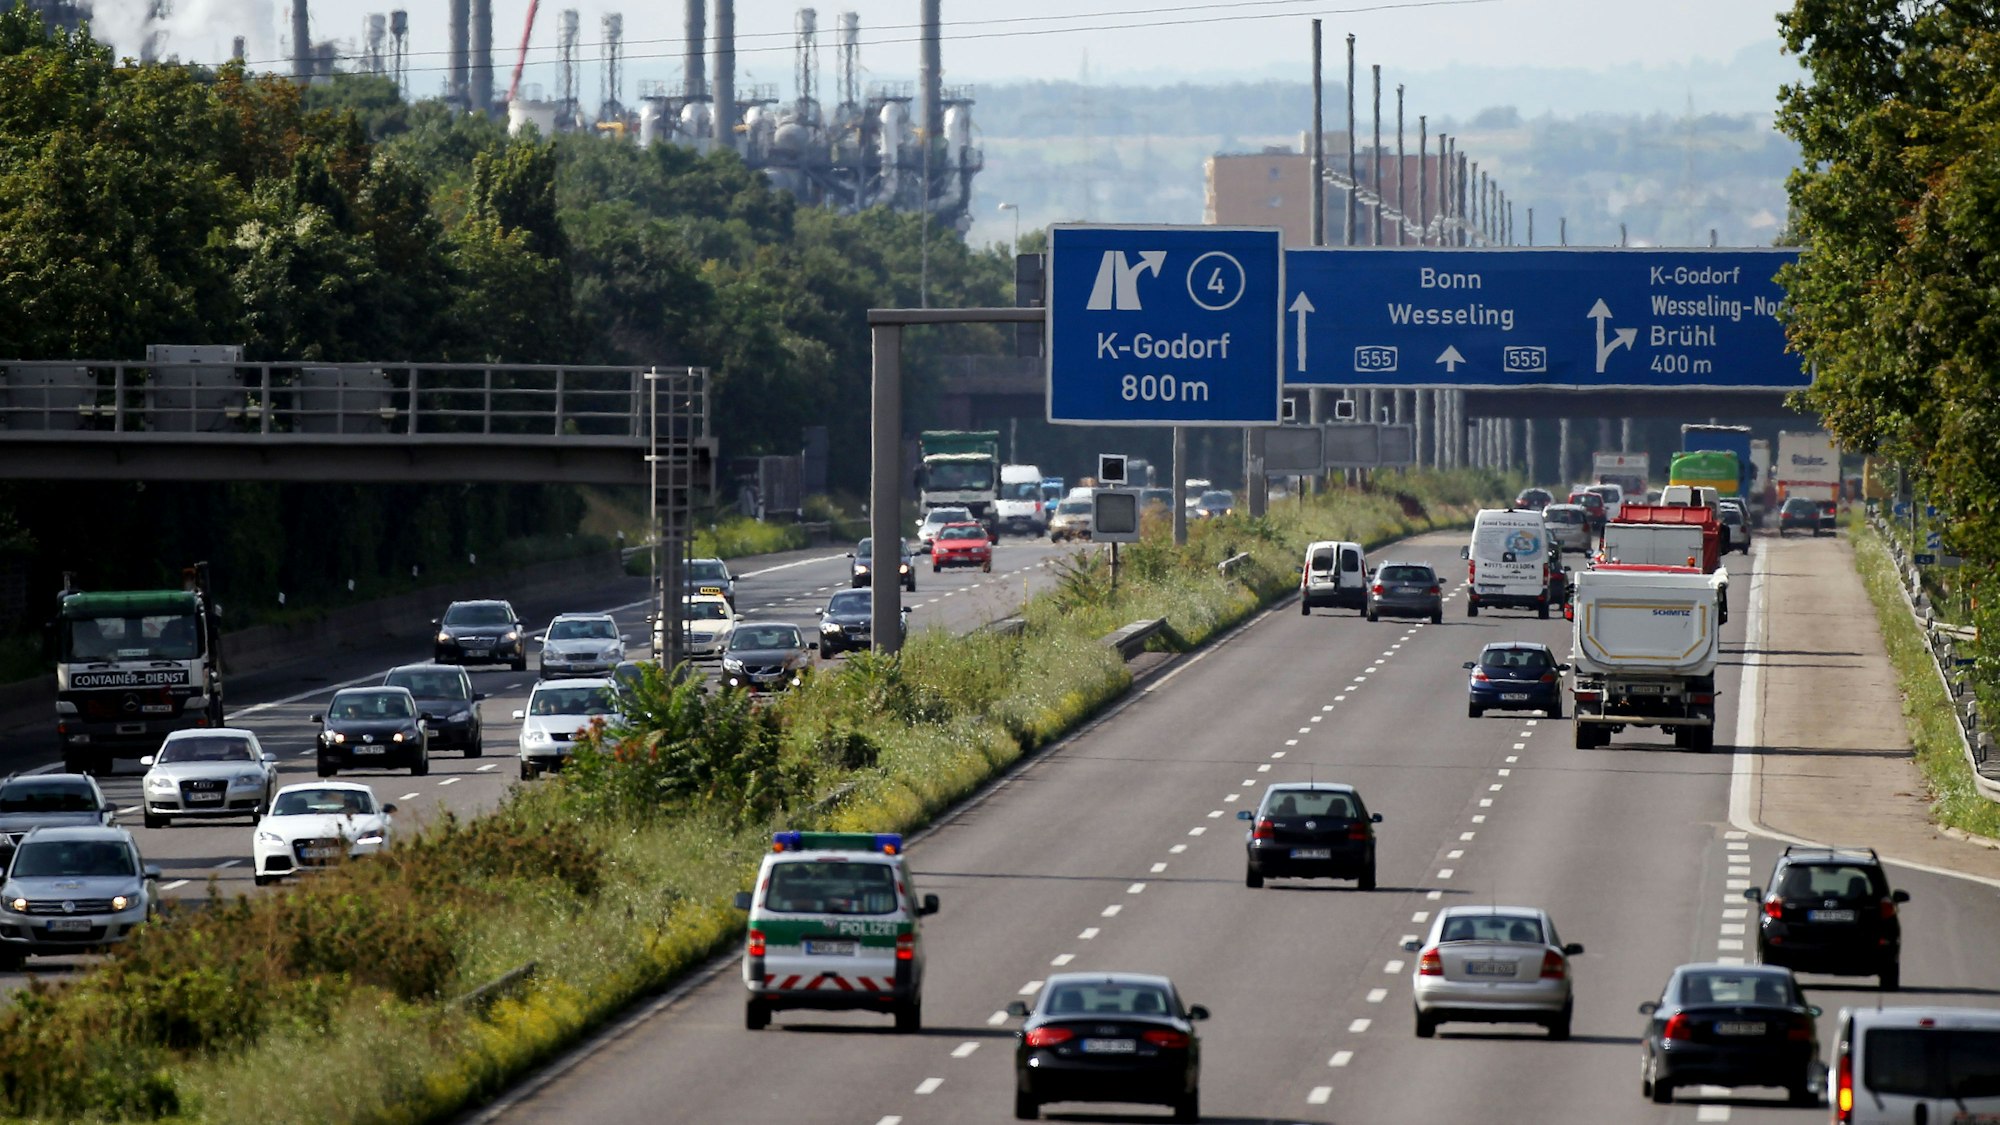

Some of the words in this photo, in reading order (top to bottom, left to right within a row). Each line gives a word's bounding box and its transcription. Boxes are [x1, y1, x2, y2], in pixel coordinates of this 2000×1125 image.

[1207, 267, 1225, 294] 4
[1420, 267, 1482, 289] Bonn
[1650, 266, 1740, 286] K-Godorf
[1387, 303, 1514, 331] Wesseling
[1097, 332, 1230, 359] K-Godorf
[1650, 325, 1717, 346] Brühl
[1360, 351, 1392, 367] 555
[1509, 351, 1541, 367] 555
[1650, 354, 1689, 374] 400
[1693, 359, 1712, 374] m
[1121, 374, 1176, 401] 800
[1181, 381, 1209, 401] m
[74, 672, 185, 686] CONTAINER-DIENST
[839, 922, 898, 936] POLIZEI
